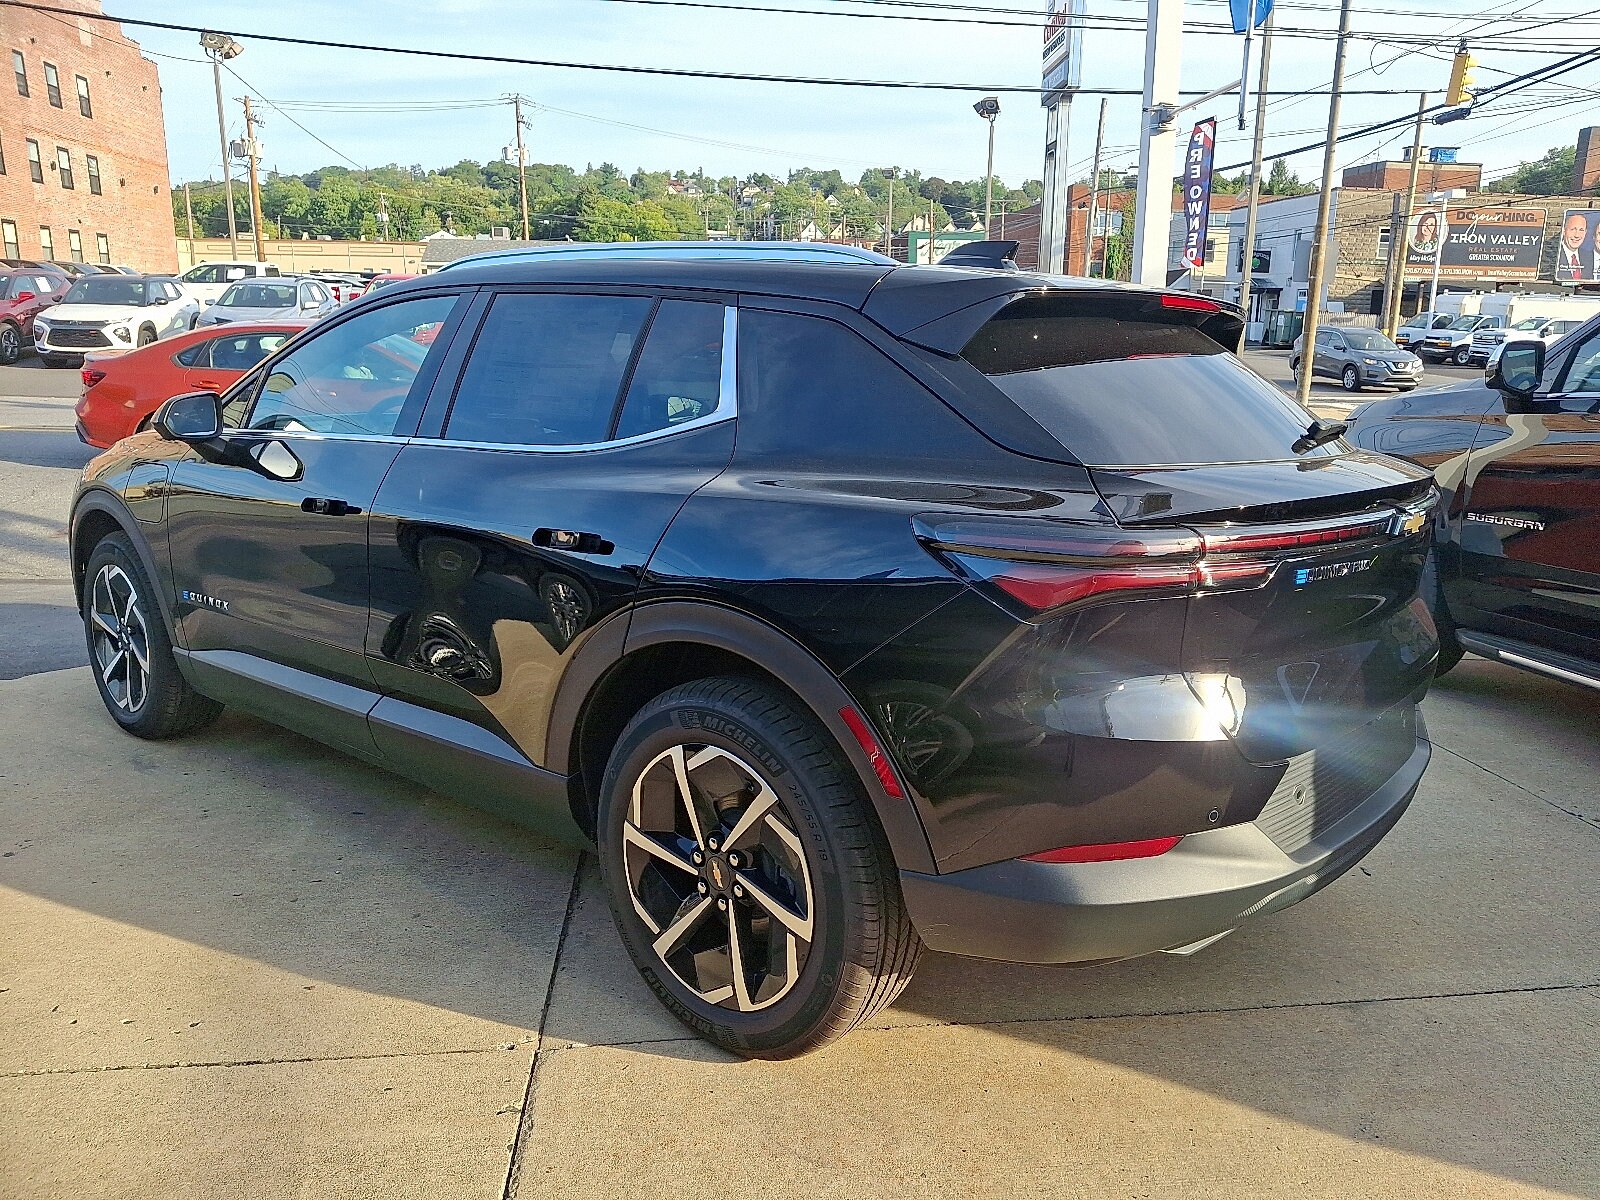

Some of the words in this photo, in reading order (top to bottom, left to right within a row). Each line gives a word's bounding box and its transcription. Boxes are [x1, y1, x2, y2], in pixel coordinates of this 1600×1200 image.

[1456, 211, 1477, 220] DO
[1450, 233, 1486, 244] IRON
[1490, 234, 1539, 246] VALLEY
[1469, 253, 1489, 261] GREATER
[1466, 511, 1546, 531] SUBURBAN
[182, 590, 229, 611] EQUINOX
[704, 715, 782, 773] MICHELIN
[787, 784, 818, 830] 245/55
